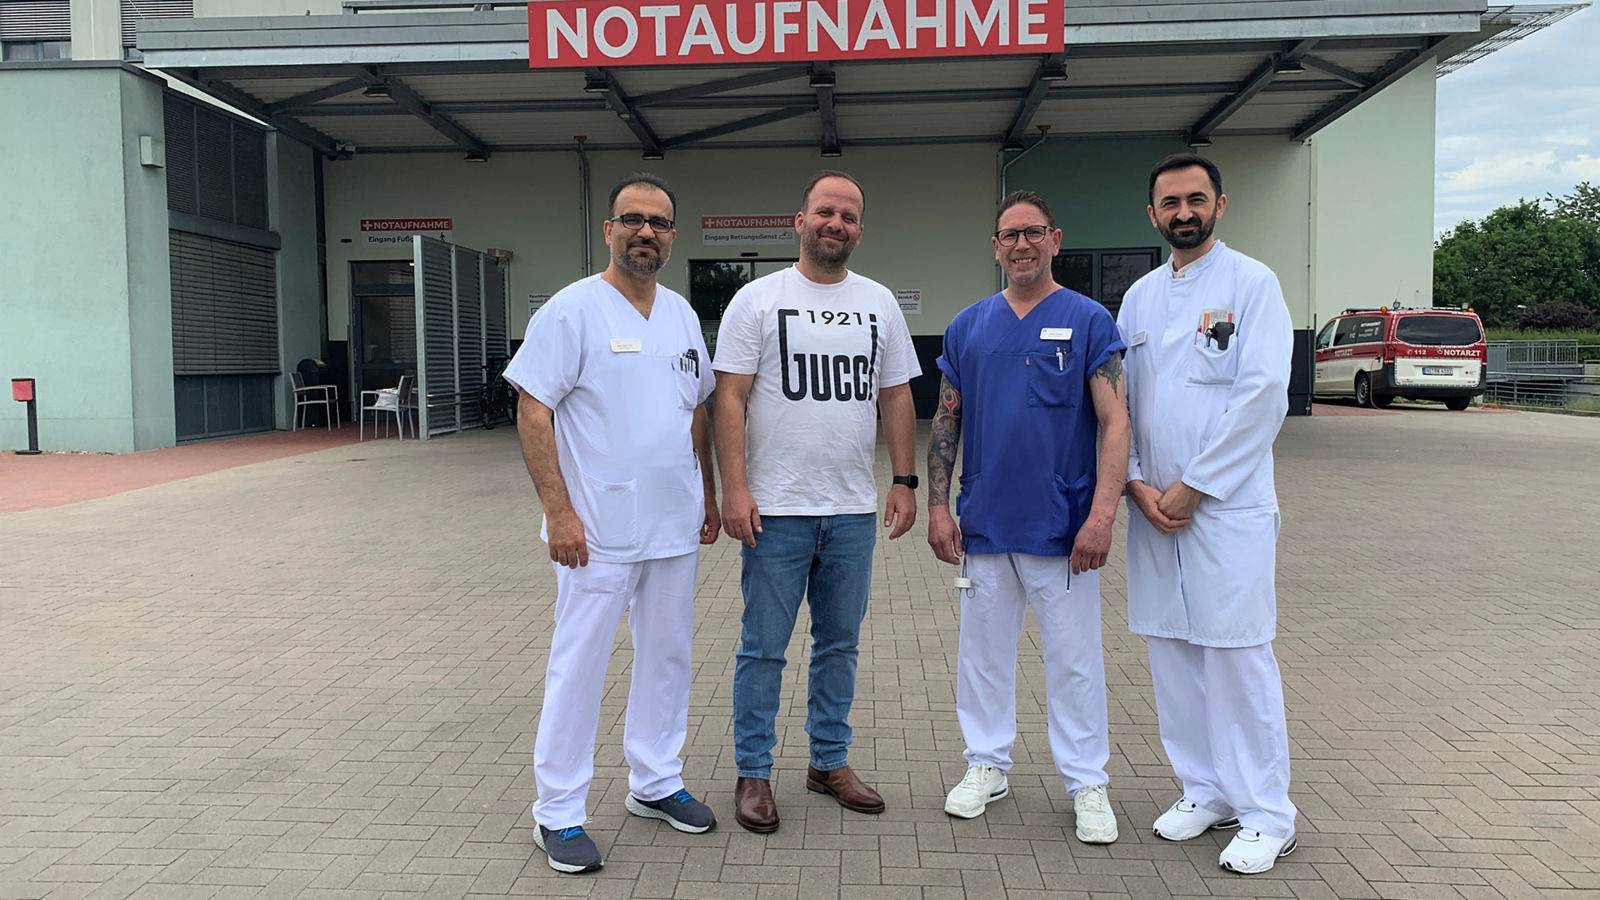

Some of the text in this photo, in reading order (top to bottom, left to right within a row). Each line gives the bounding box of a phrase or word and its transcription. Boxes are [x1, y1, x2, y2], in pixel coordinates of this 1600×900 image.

[546, 0, 1049, 59] NOTAUFNAHME
[373, 220, 449, 229] NOTAUFNAHME
[715, 218, 792, 227] NOTAUFNAHME
[730, 233, 777, 241] Rettungsdienst
[807, 309, 862, 325] 1921
